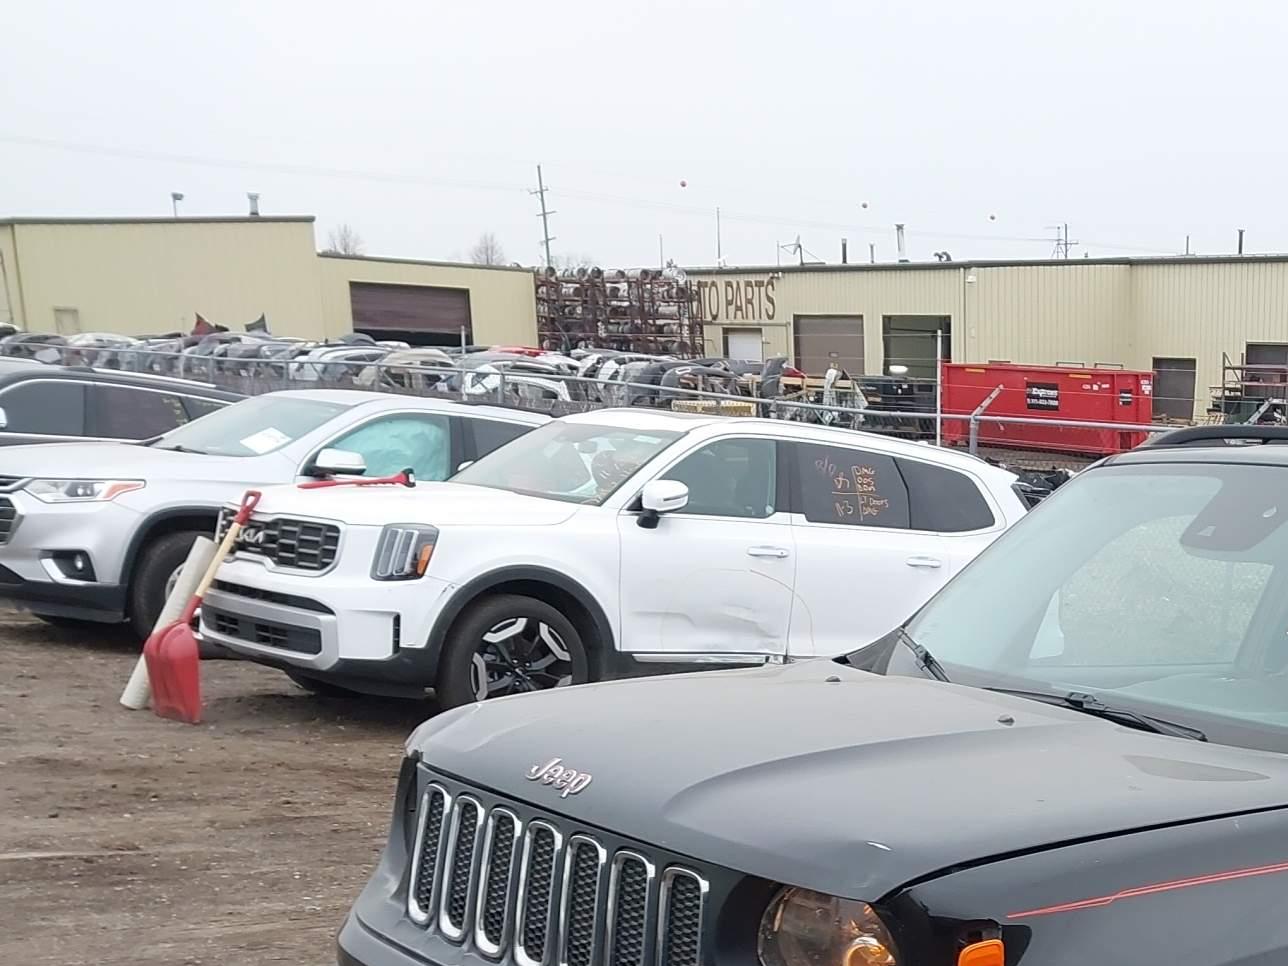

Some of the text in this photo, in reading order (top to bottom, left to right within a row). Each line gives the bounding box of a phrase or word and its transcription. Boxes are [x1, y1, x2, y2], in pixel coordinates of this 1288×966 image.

[688, 279, 776, 320] UTO PARTS
[525, 757, 592, 799] Jeep
